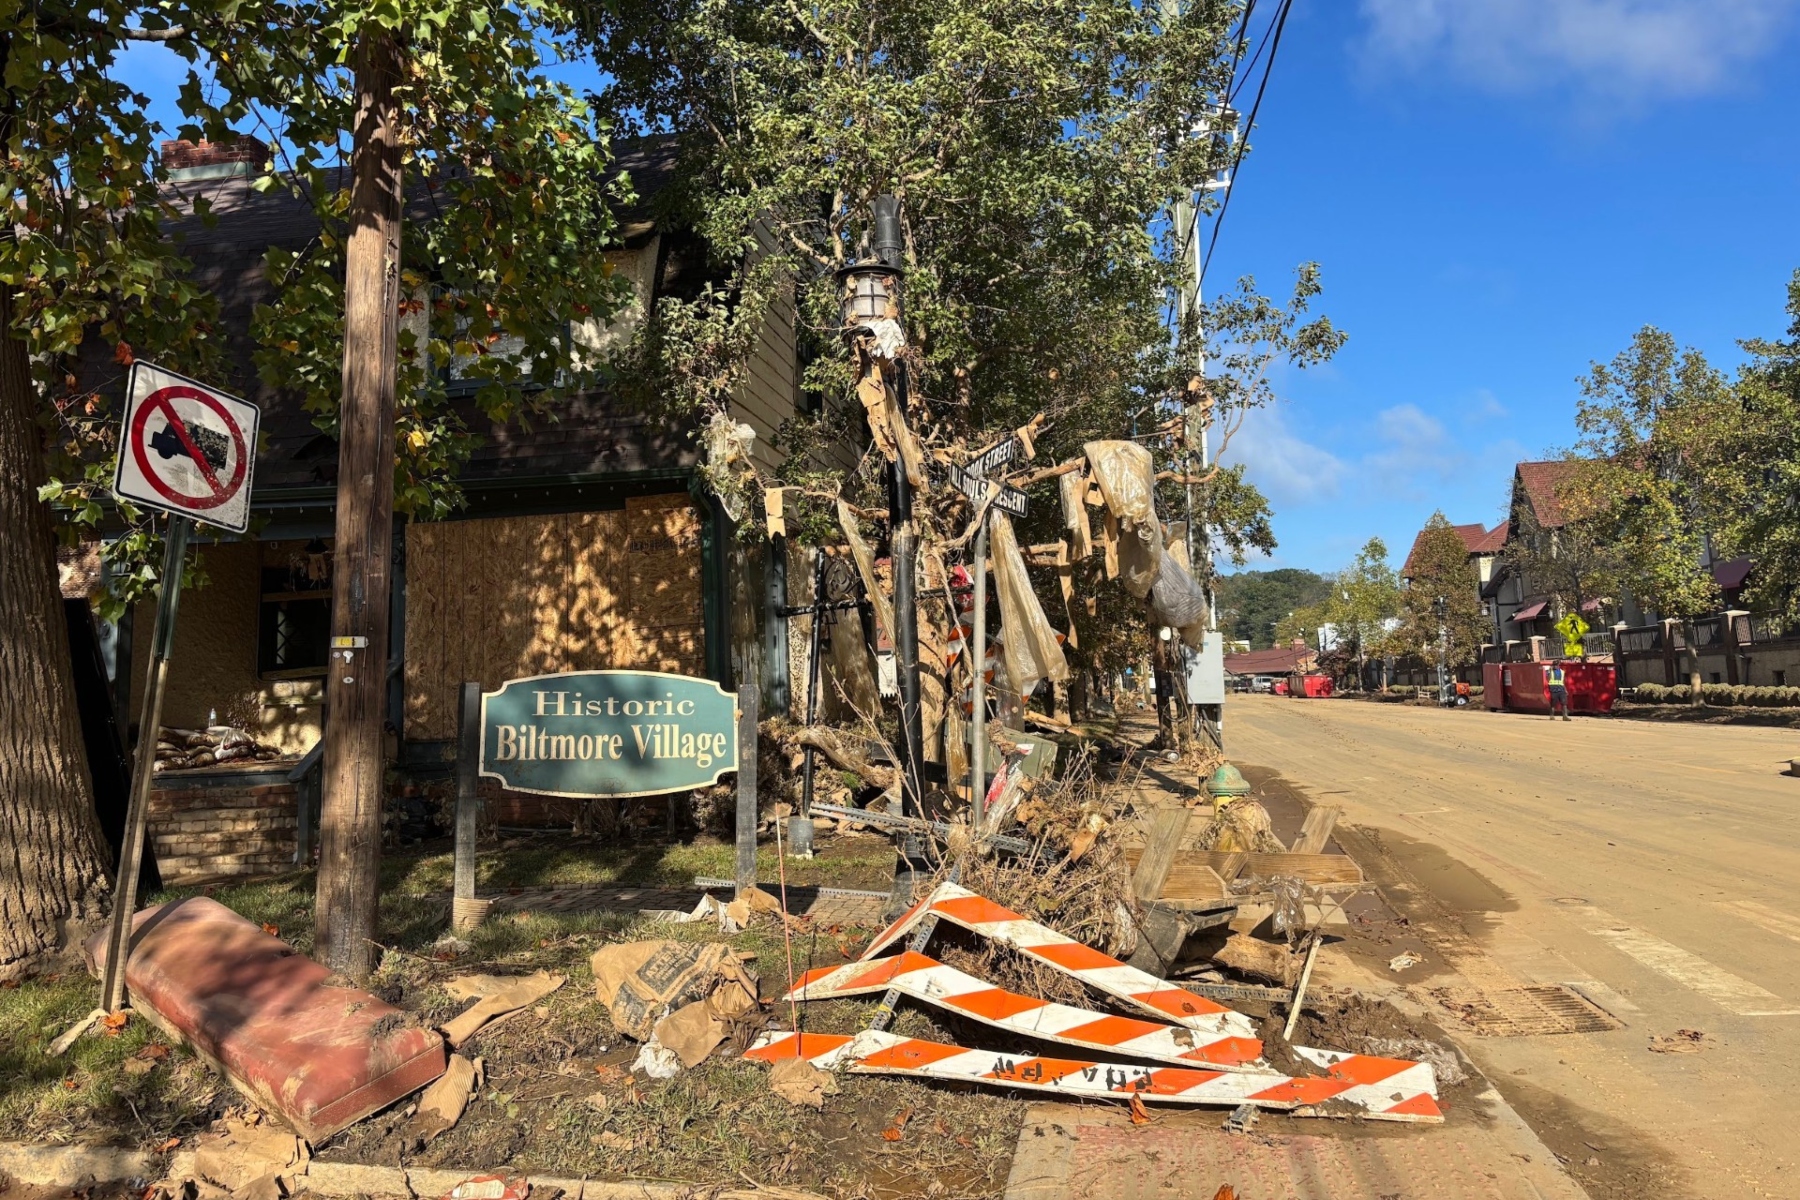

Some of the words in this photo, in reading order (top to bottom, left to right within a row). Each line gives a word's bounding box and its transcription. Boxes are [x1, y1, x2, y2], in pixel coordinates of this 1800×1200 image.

[985, 440, 1012, 471] STREET
[951, 465, 962, 489] ALL
[962, 475, 987, 500] SOULS
[532, 691, 695, 716] Historic
[494, 724, 623, 761] Biltmore
[631, 723, 727, 768] Village
